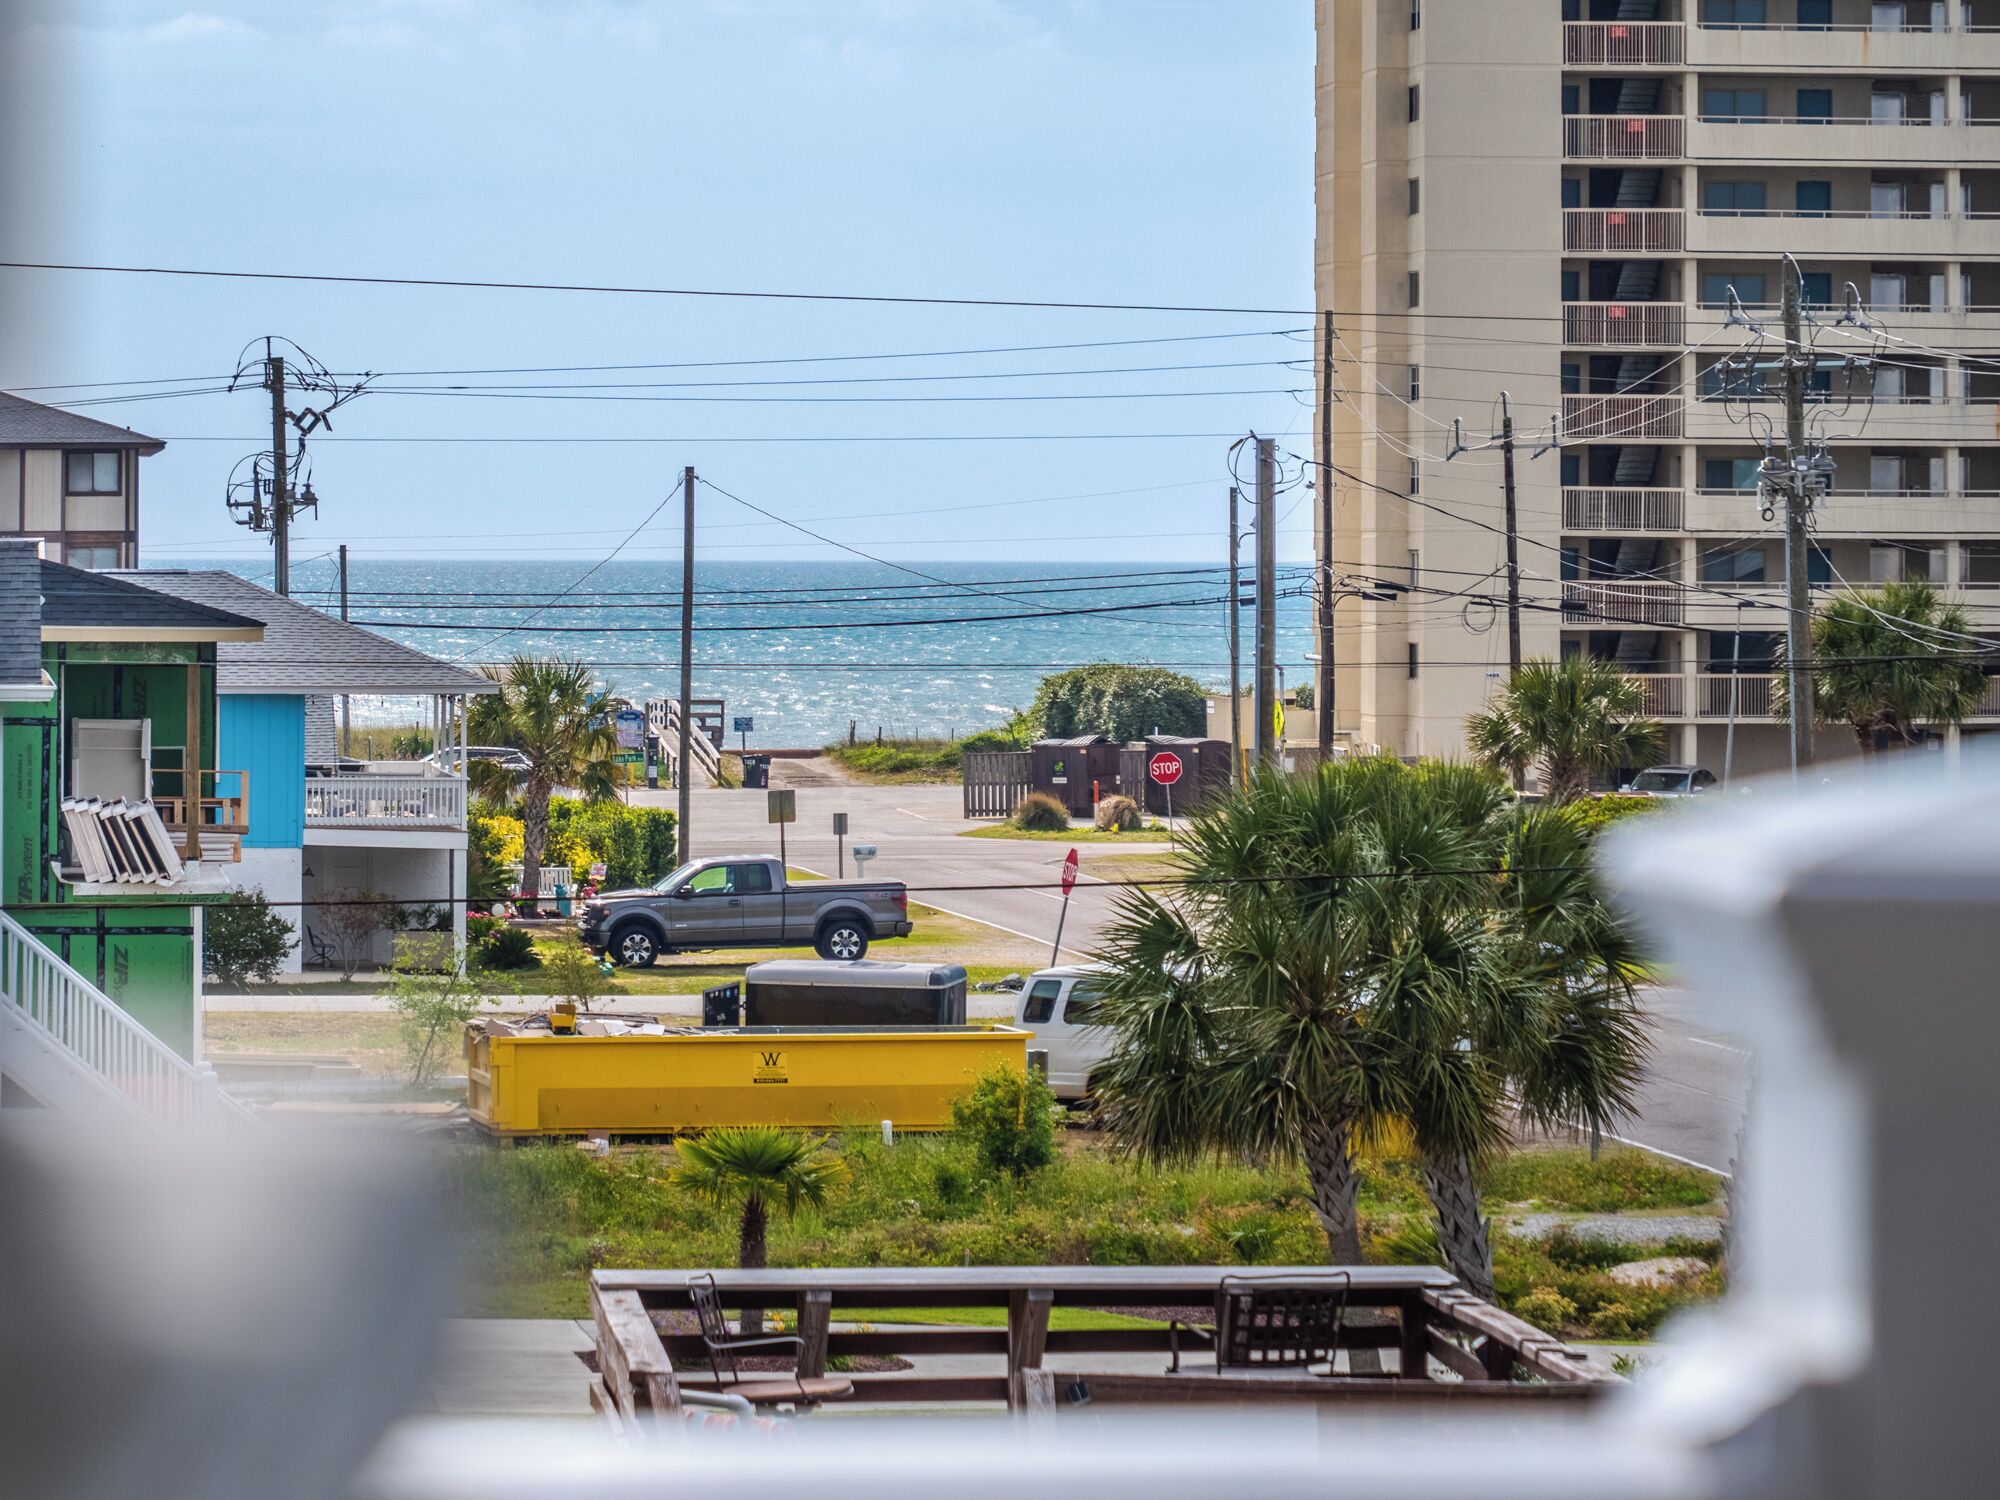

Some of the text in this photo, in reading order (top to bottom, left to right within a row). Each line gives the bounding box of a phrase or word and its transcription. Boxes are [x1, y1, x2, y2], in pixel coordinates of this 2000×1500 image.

[625, 754, 636, 762] Park
[1152, 762, 1180, 775] STOP
[1063, 861, 1078, 883] STOP
[114, 943, 129, 985] ZIP
[761, 1052, 781, 1066] W
